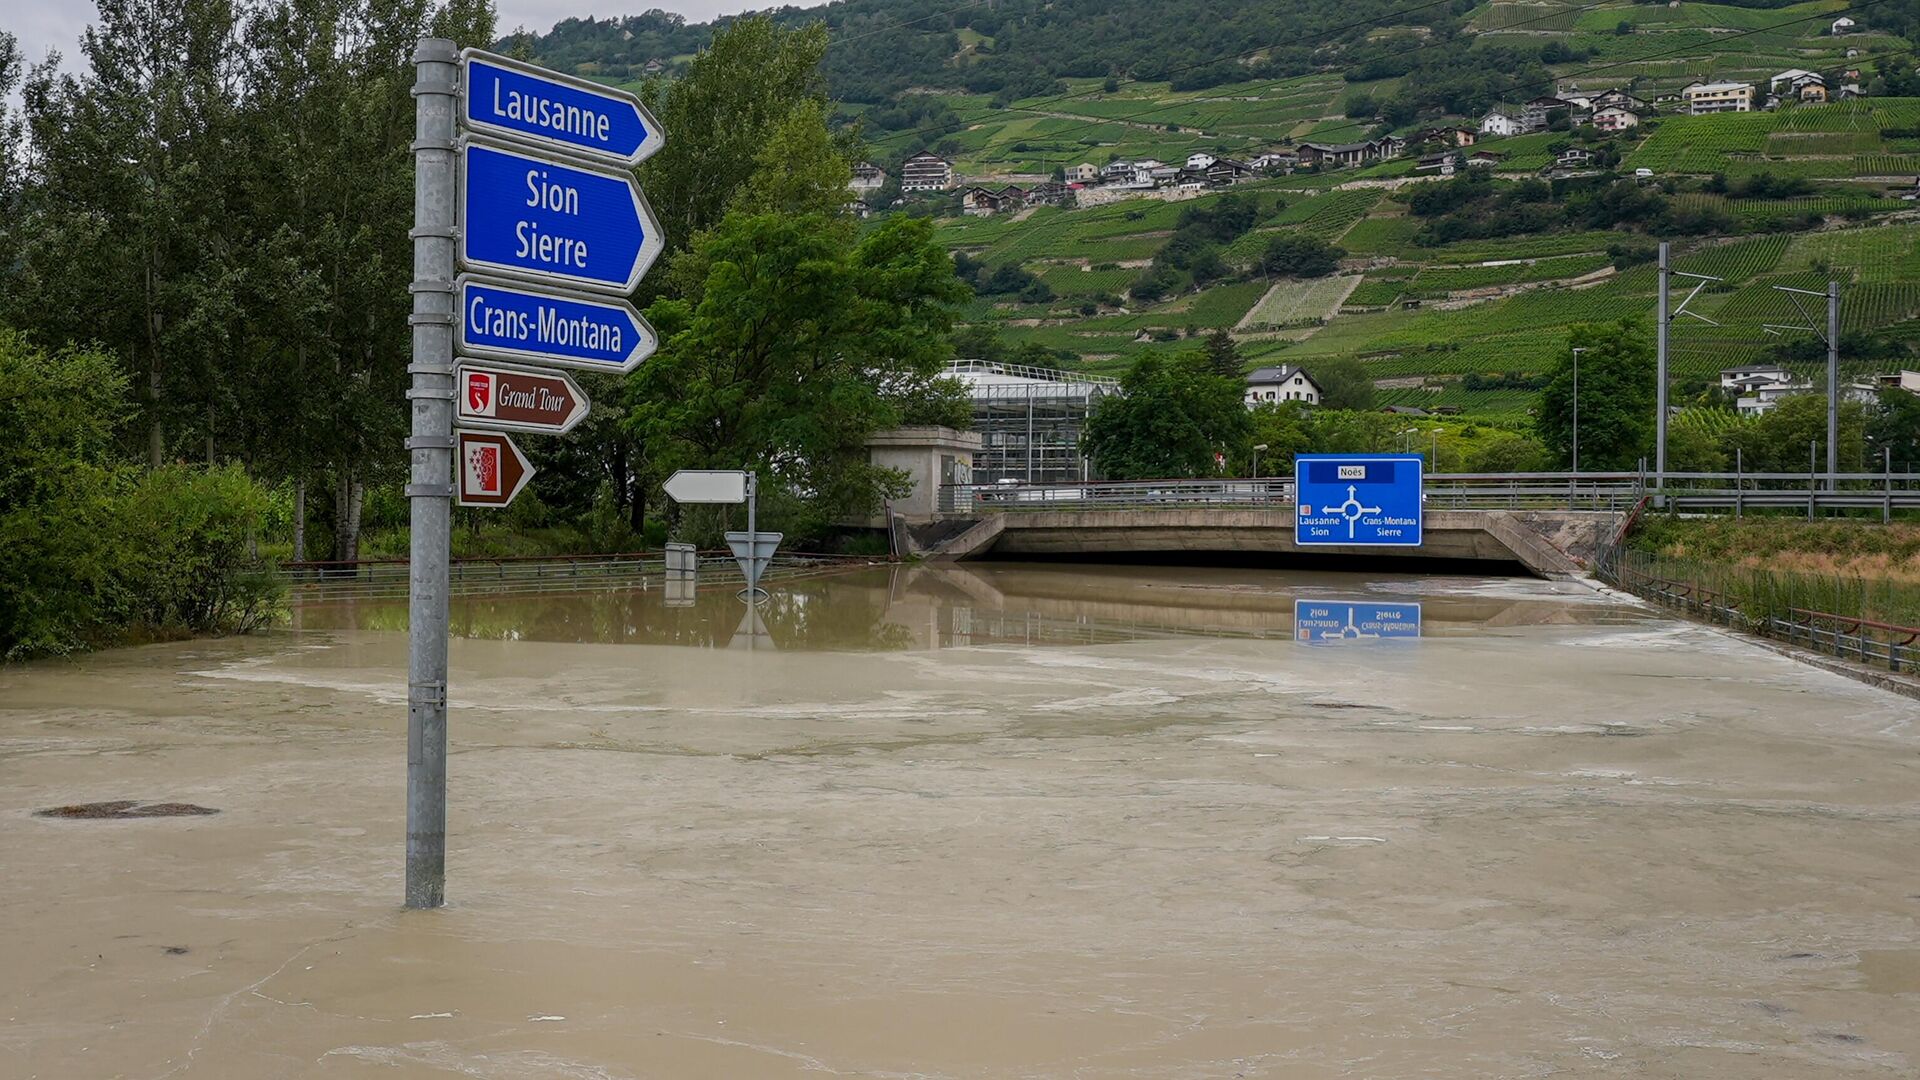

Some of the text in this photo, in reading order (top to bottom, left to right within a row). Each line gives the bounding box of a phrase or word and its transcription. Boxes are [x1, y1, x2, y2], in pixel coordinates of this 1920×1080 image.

[493, 77, 610, 141] Lausanne
[526, 170, 579, 216] Sion
[515, 220, 588, 268] Sierre
[470, 296, 621, 353] Crans-Montana
[499, 383, 536, 409] Grand
[539, 387, 565, 412] Tour
[1340, 467, 1362, 476] Noës
[1299, 516, 1340, 525] Lausanne
[1362, 516, 1416, 526] Crans-Montana
[1310, 527, 1329, 536] Sion
[1377, 527, 1402, 537] Sierre
